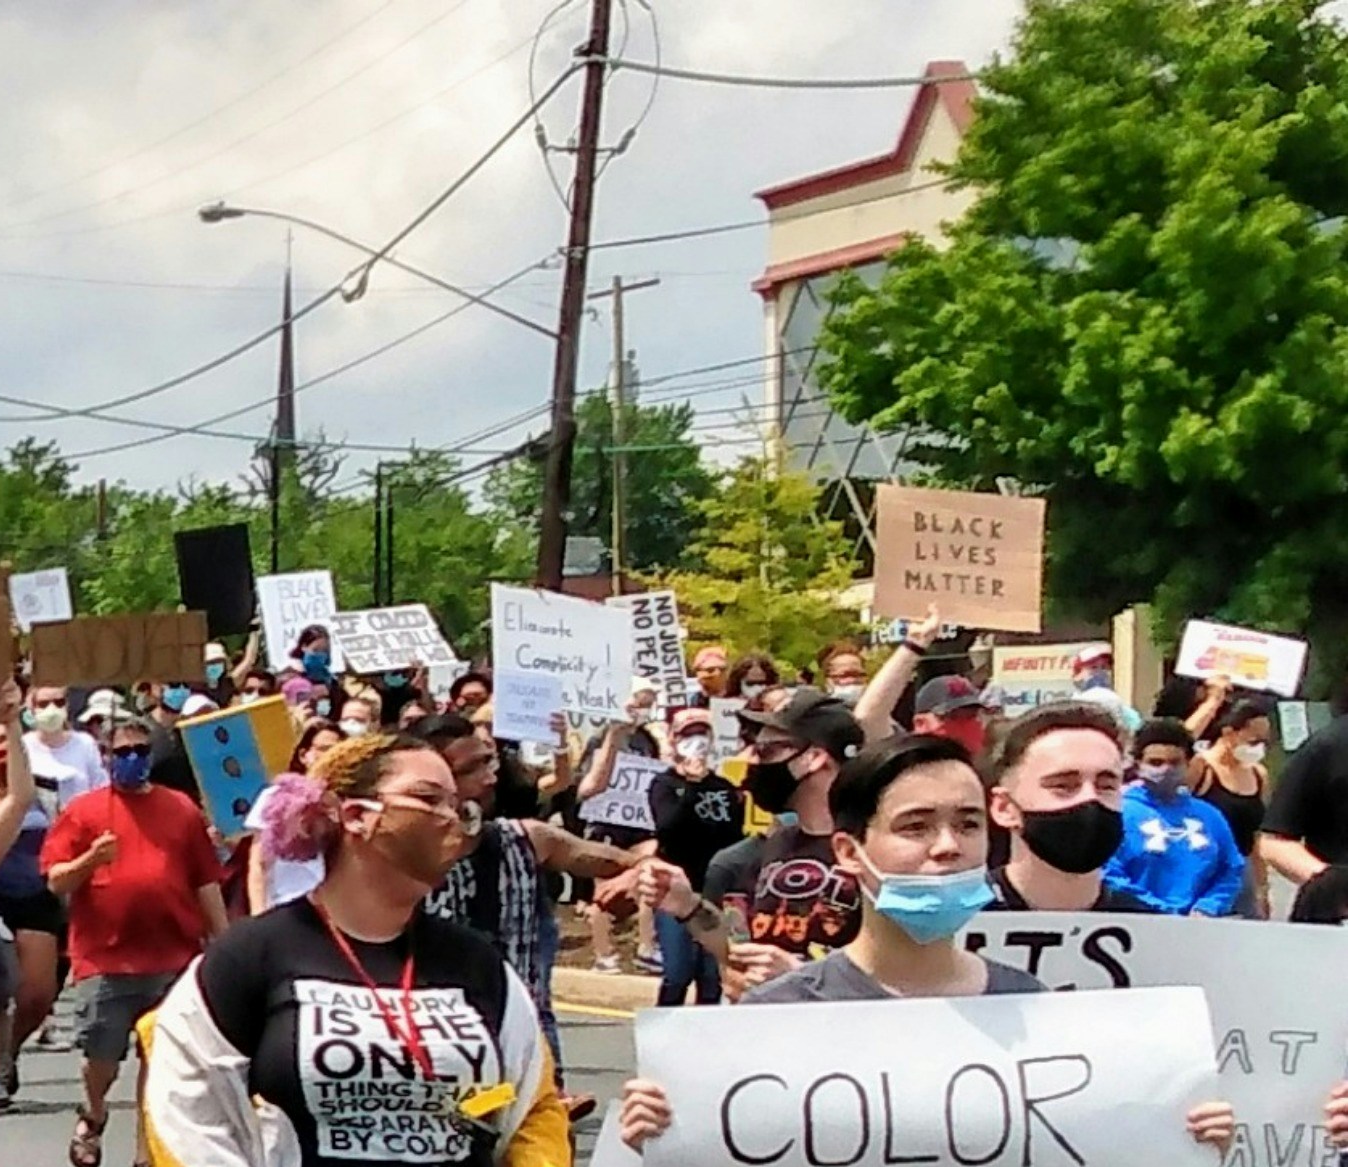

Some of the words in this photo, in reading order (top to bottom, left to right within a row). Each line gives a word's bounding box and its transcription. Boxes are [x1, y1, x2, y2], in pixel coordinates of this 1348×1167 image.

[913, 510, 1003, 540] BLACK
[914, 541, 997, 567] LIVES
[904, 569, 1005, 598] MATTER
[632, 599, 654, 630] NO
[654, 595, 675, 626] NO
[515, 643, 599, 683] Complicity
[635, 636, 661, 685] PEA
[658, 629, 688, 706] JUSTICE
[605, 801, 648, 823] FOR
[305, 989, 459, 1012] LAUNDRY
[313, 1006, 361, 1036] IS
[369, 1014, 483, 1041] THE
[313, 1039, 487, 1083] ONLY
[313, 1081, 413, 1098] THING
[418, 1083, 493, 1102] THA
[318, 1098, 444, 1116] SHOULD
[327, 1113, 466, 1133] SEPARAT
[330, 1129, 374, 1151] BY
